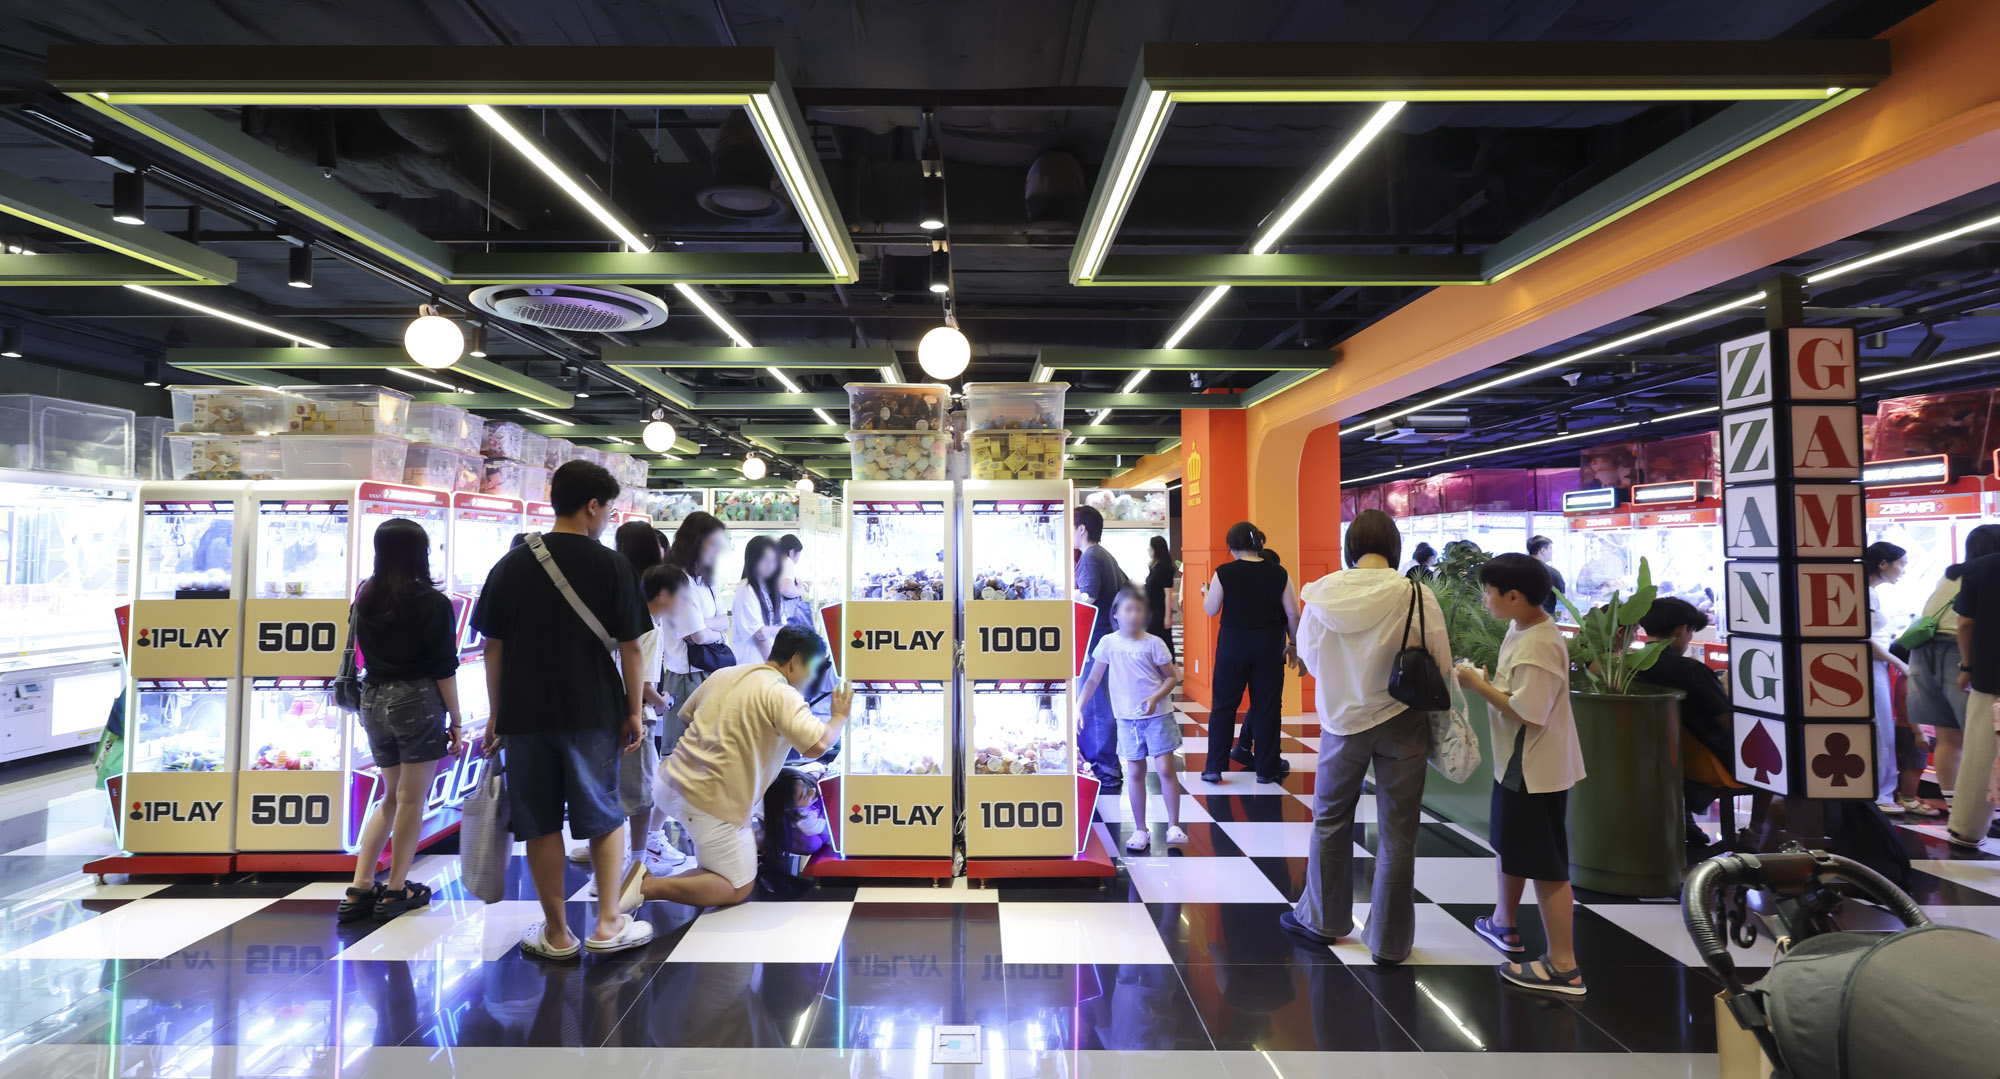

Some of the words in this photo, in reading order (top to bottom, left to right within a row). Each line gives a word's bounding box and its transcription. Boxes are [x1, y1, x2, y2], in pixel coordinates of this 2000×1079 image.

[1879, 501, 1935, 515] ZEMNA
[1726, 342, 1781, 701] ZZANG
[1794, 337, 1864, 707] GAMES
[151, 628, 230, 649] 1PLAY
[258, 622, 336, 652] 500
[865, 630, 945, 651] 1PLAY
[979, 626, 1061, 652] 1000
[144, 801, 224, 822] 1PLAY
[251, 794, 330, 825] 500
[863, 804, 944, 826] 1PLAY
[980, 801, 1063, 828] 1000
